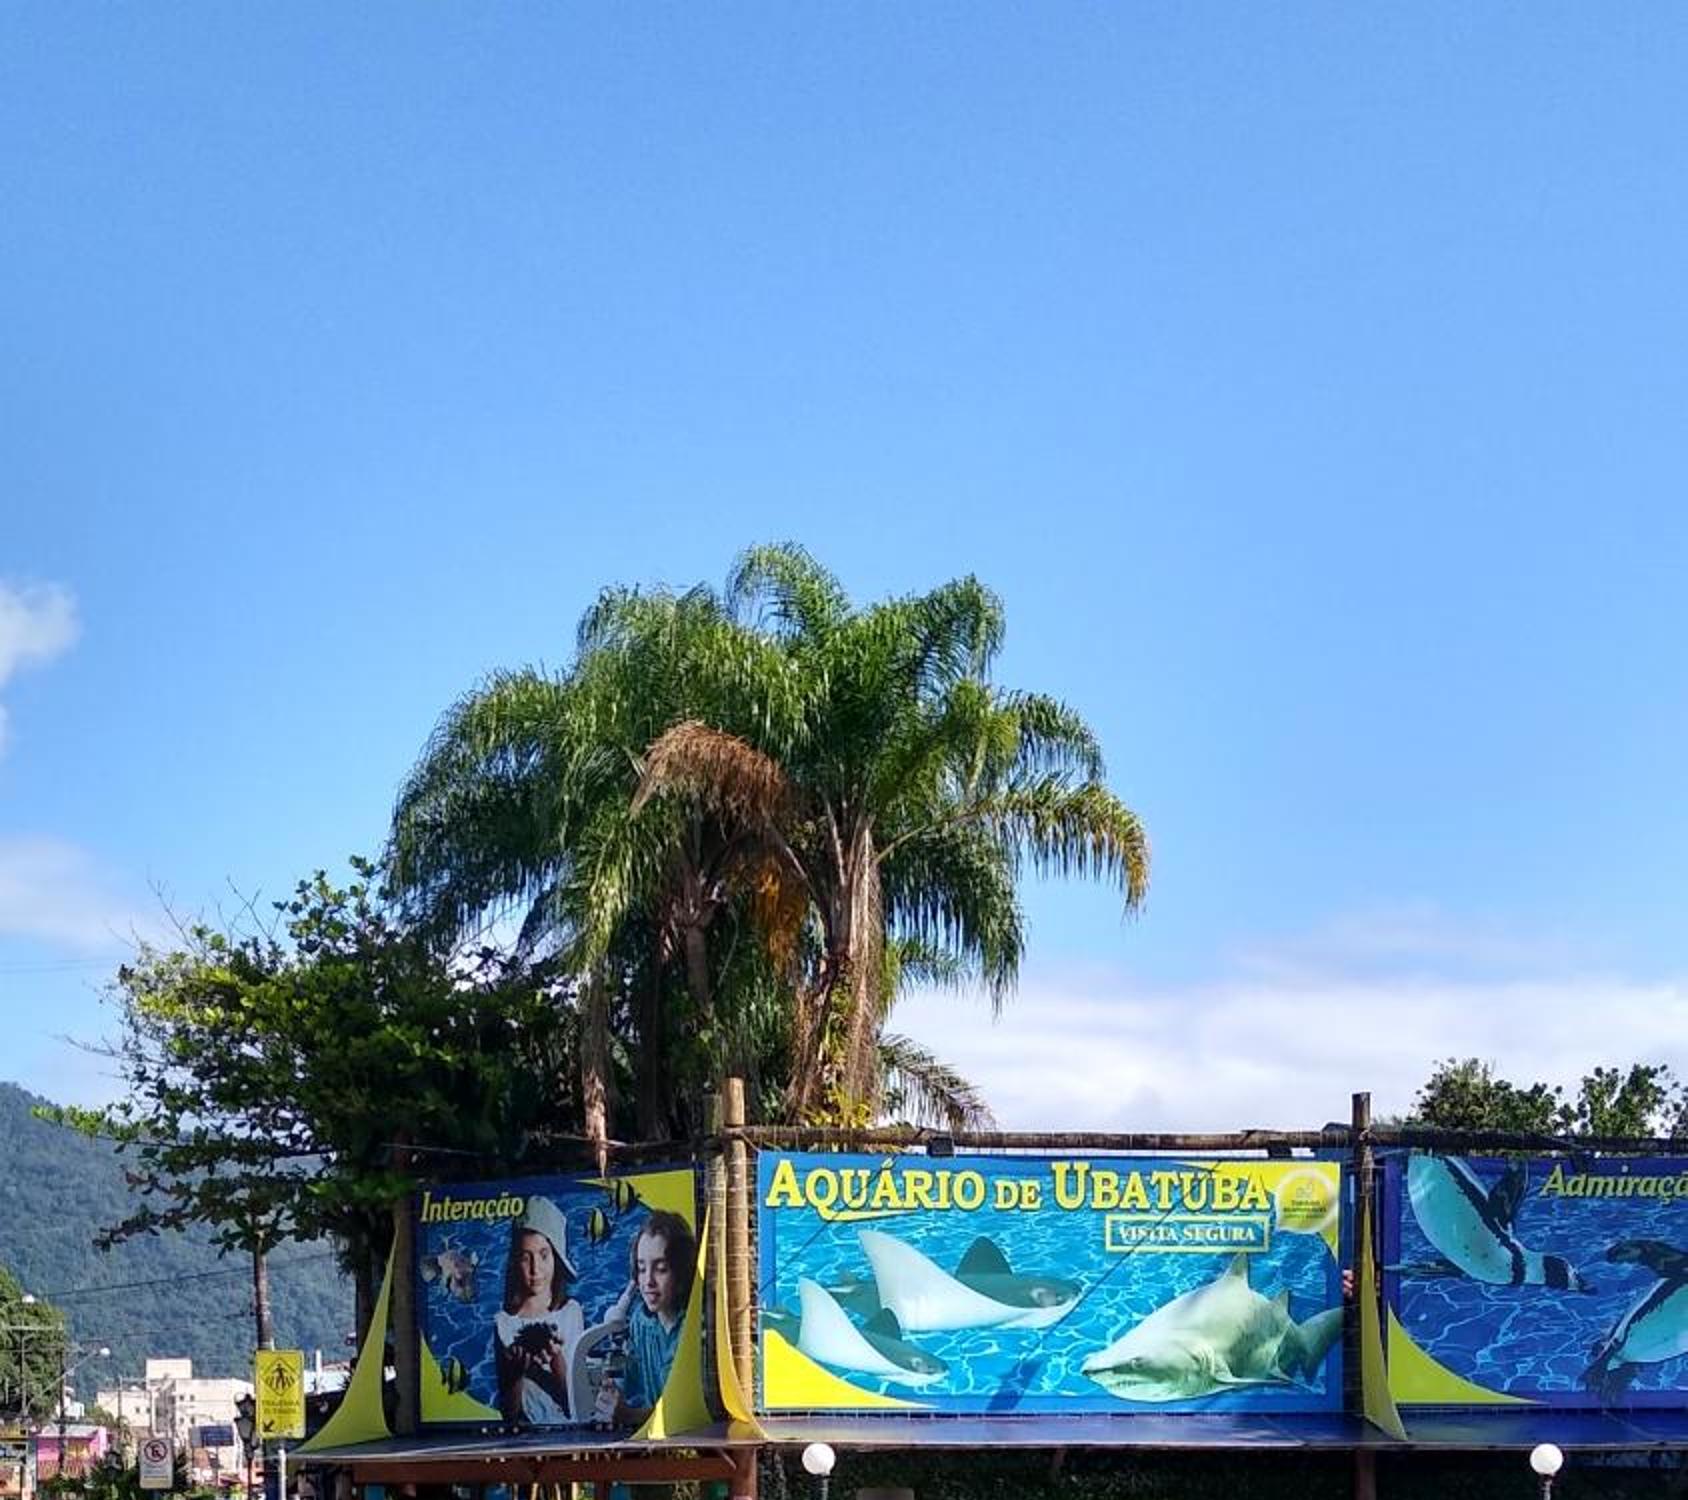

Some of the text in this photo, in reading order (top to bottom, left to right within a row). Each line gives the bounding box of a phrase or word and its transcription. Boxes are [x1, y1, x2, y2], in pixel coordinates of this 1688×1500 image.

[765, 1158, 1271, 1222] AQUÁRIO DE UBATUBA
[420, 1191, 524, 1225] Interação
[1119, 1224, 1256, 1241] VISITA SEGURA
